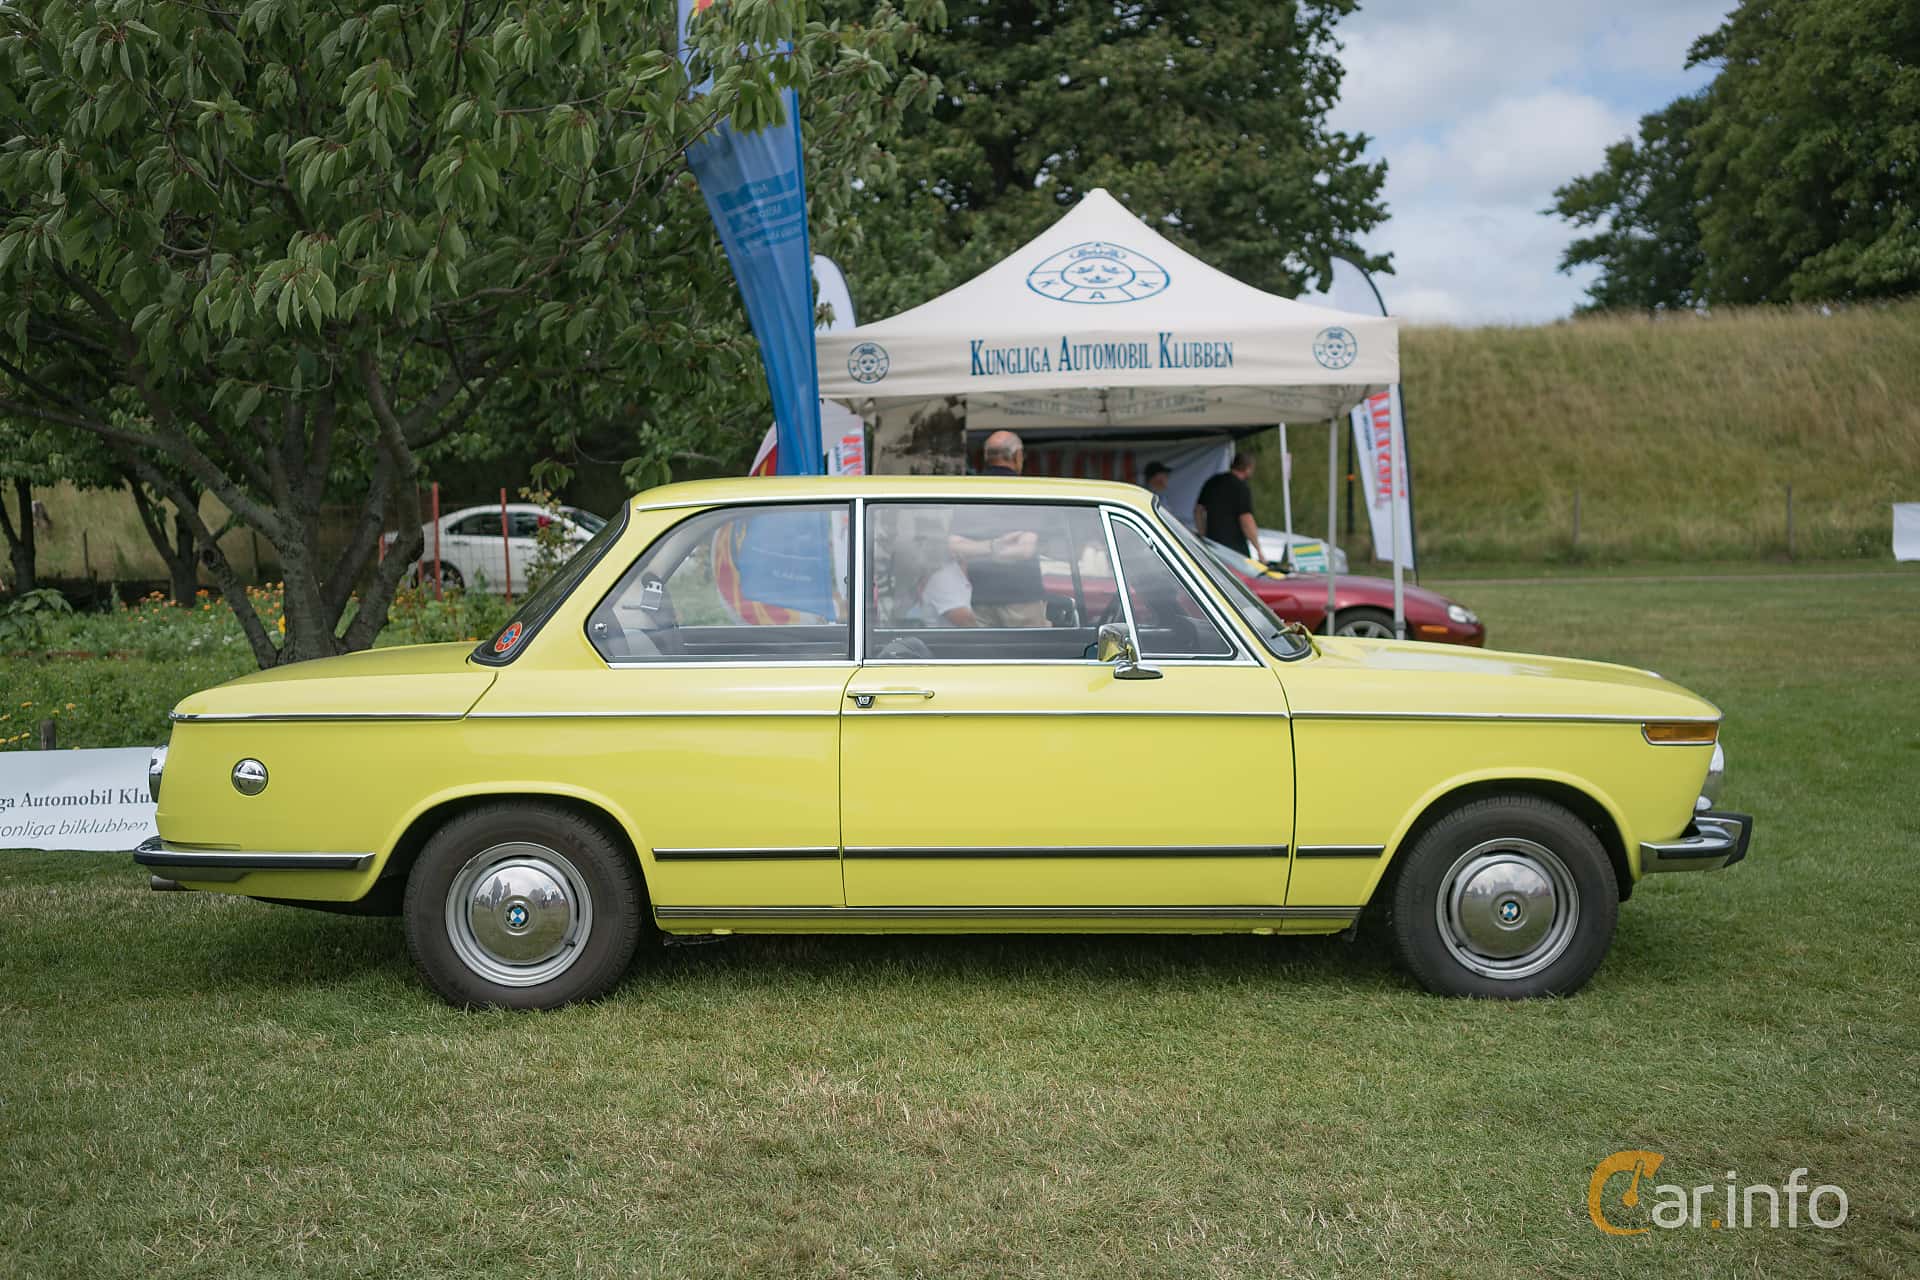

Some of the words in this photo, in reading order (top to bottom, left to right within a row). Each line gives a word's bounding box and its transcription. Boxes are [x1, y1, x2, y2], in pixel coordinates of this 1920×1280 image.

[970, 339, 1051, 376] KUNGLIGA
[1057, 335, 1153, 372] AUTOMOBIL
[1158, 331, 1235, 369] KLUBBEN
[20, 788, 112, 808] Automobil
[119, 787, 150, 804] Klu
[0, 820, 56, 840] onliga
[58, 818, 149, 836] bilklubben
